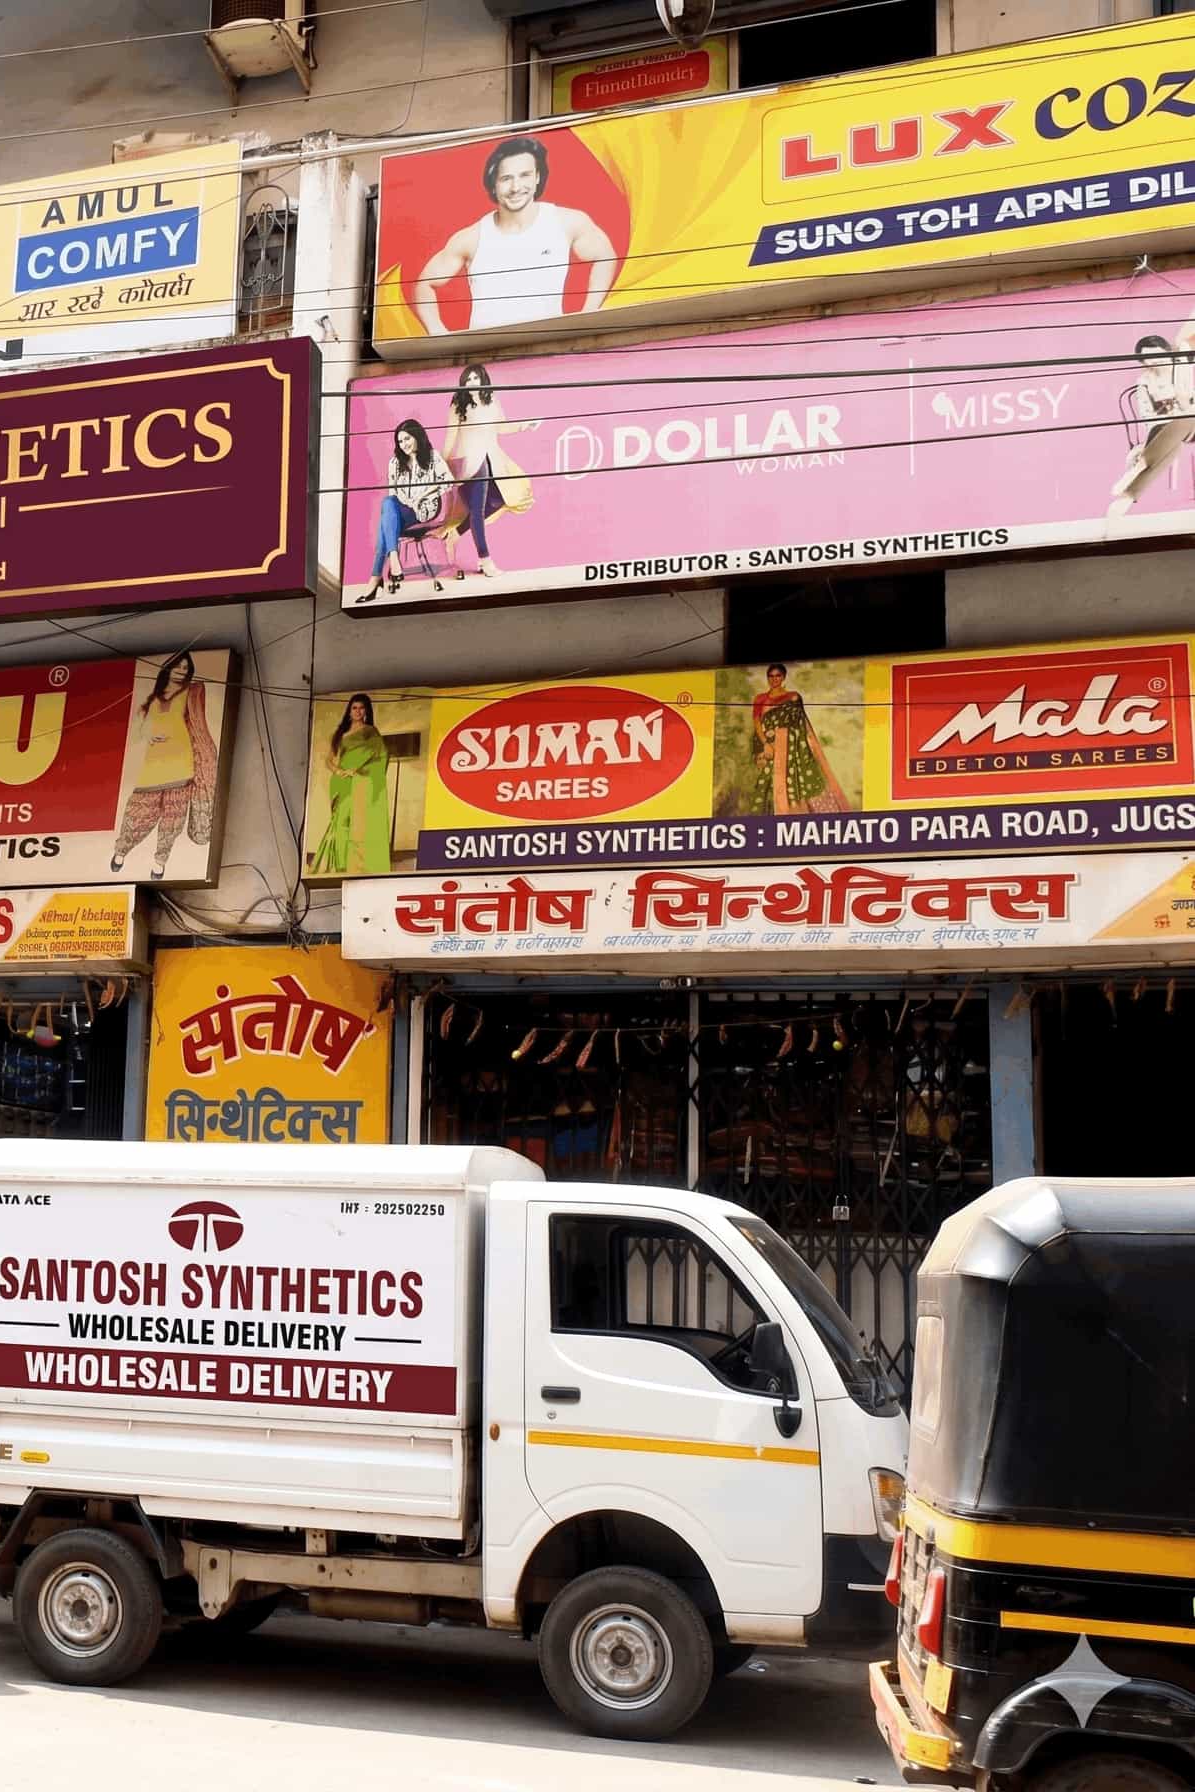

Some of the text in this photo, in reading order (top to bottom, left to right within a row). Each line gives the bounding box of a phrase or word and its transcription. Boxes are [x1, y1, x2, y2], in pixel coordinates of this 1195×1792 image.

[781, 100, 1014, 180] LUX
[41, 182, 174, 229] AMUL
[774, 217, 884, 255] SUNO
[896, 202, 979, 237] TOH
[994, 182, 1110, 224] APNE
[27, 222, 190, 280] COMFY
[611, 384, 1070, 465] DOLLAR MISSY
[734, 450, 846, 476] WOMAN
[584, 553, 728, 582] DISTRIBUTOR
[748, 541, 855, 567] SANTOSH
[862, 527, 1010, 559] SYNTHETICS
[450, 708, 663, 773] SUMAN
[918, 673, 1169, 753] Mala
[916, 746, 1169, 774] EDETON SAREES
[496, 777, 609, 803] SAREES
[445, 832, 567, 859] SANTOSH
[576, 823, 747, 855] SYNTHETICS
[776, 817, 900, 847] MAHATO
[910, 814, 991, 841] PARA
[1001, 807, 1100, 839] ROAD,
[1111, 803, 1195, 833] JUGS
[396, 866, 1076, 934] संतोष सिन्थेटिक्स
[179, 975, 368, 1076] संतोष
[24, 1195, 51, 1206] ACE
[374, 1203, 445, 1216] 292502250
[181, 1264, 424, 1319] SYNTHETICS
[68, 1313, 347, 1352] WHOLESALE DELIVERY
[24, 1351, 393, 1404] WHOLESALE DELIVERY
